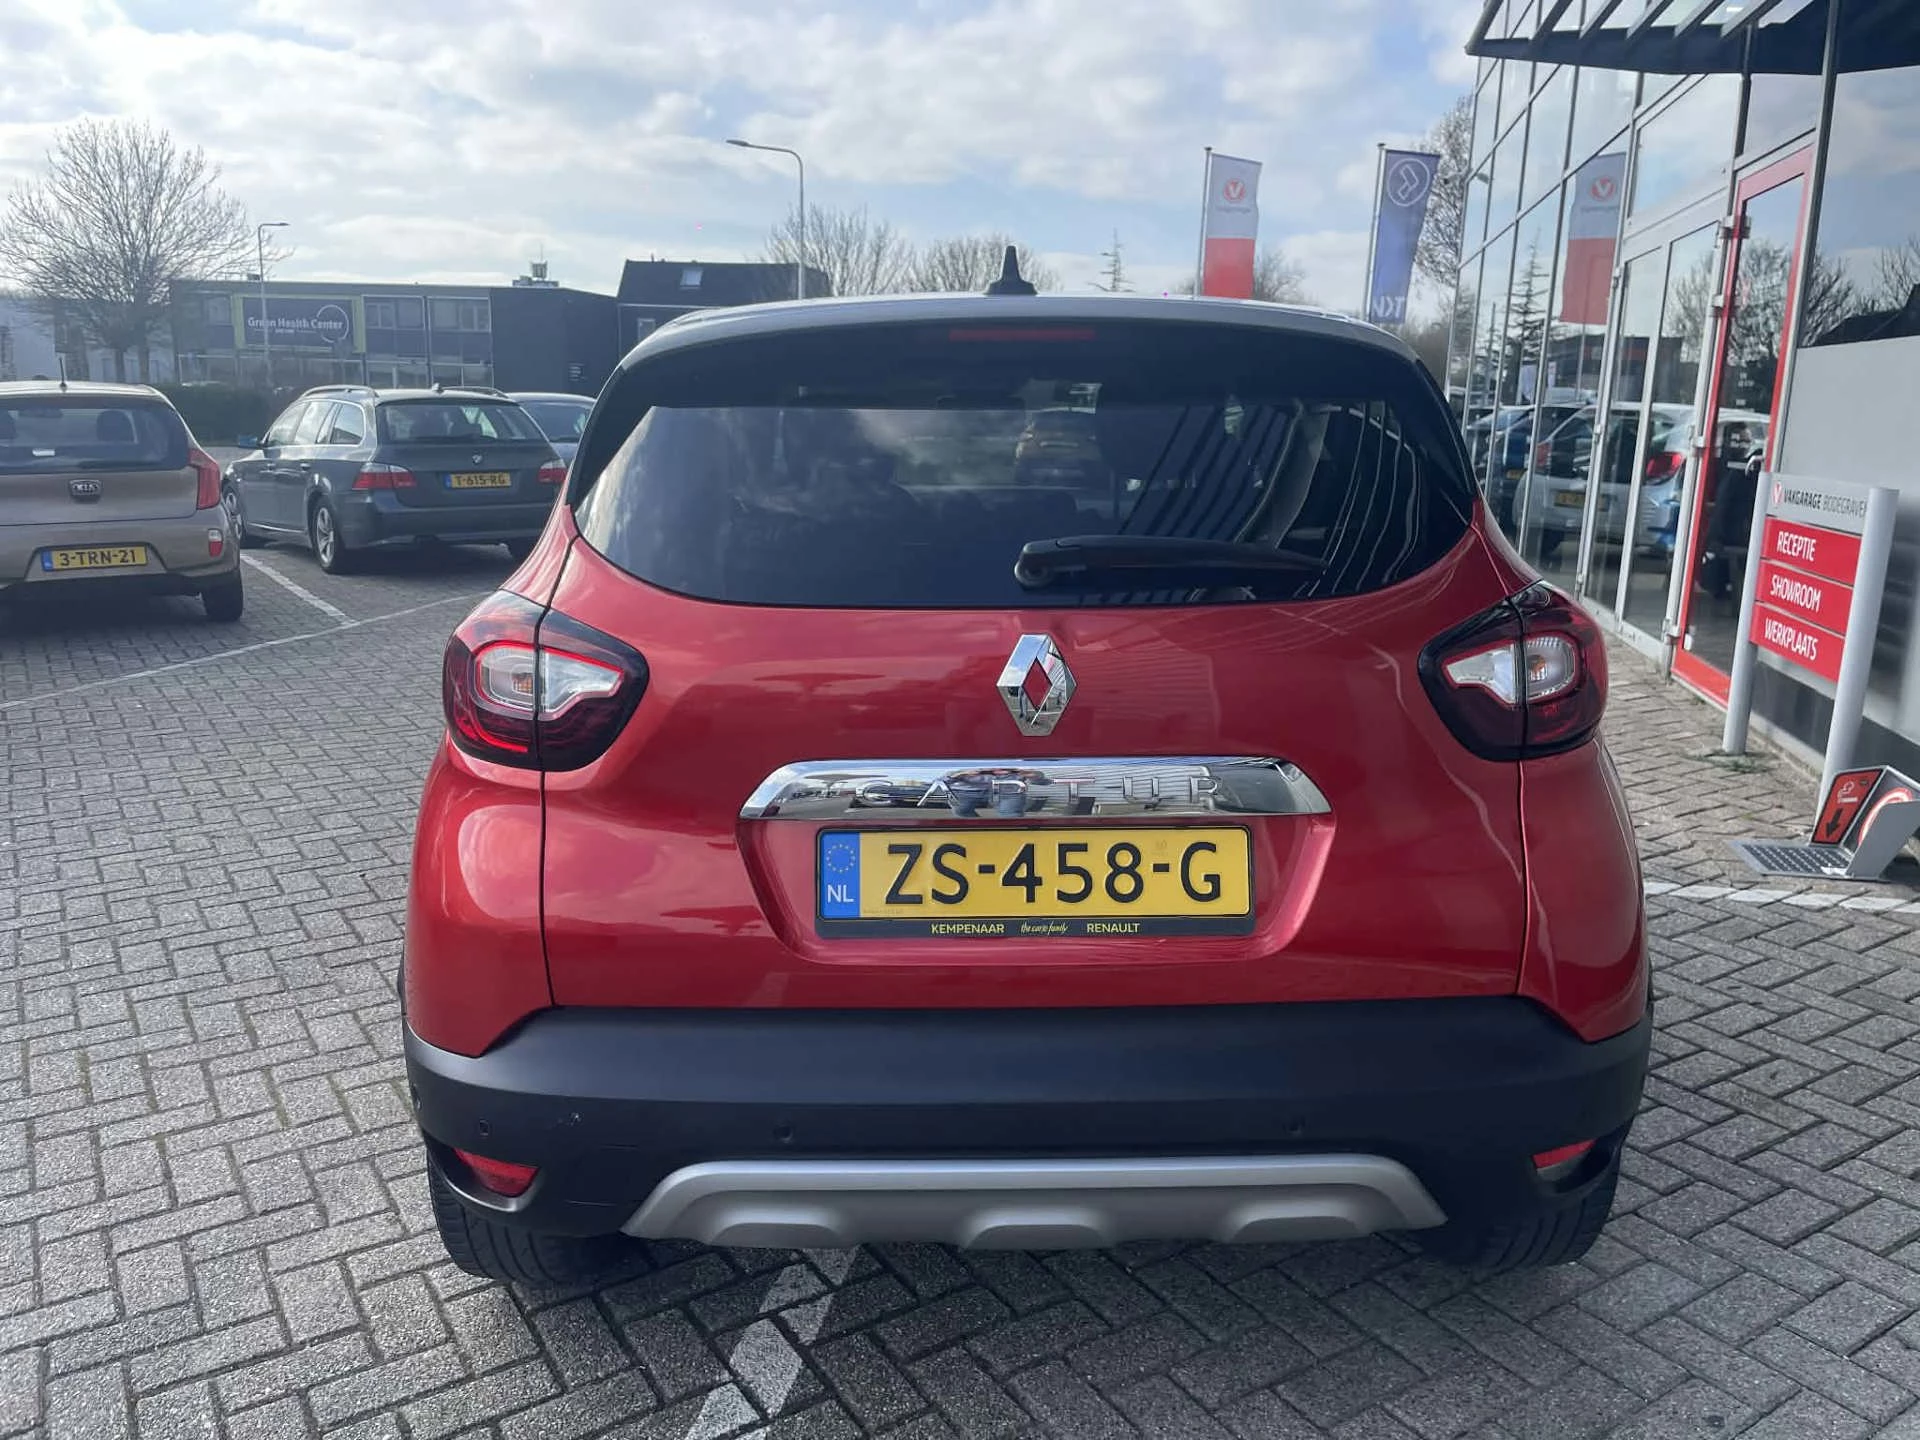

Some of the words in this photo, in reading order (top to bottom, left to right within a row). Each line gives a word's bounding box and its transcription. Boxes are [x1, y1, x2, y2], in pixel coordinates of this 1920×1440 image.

[278, 318, 309, 329] Health
[311, 319, 343, 331] Center
[1784, 488, 1822, 510] VAKGARAGE
[59, 549, 137, 568] 3-TRN-21
[1776, 530, 1817, 562] RECEPTIE
[1770, 574, 1822, 613] SHOWROOM
[1764, 617, 1819, 661] WERKPLAATS
[855, 776, 1222, 807] CAPTUR
[884, 841, 1222, 905] ZS-458-G
[826, 884, 854, 904] NL
[931, 923, 1005, 935] KEMPENAAR
[1086, 922, 1141, 933] RENAULT
